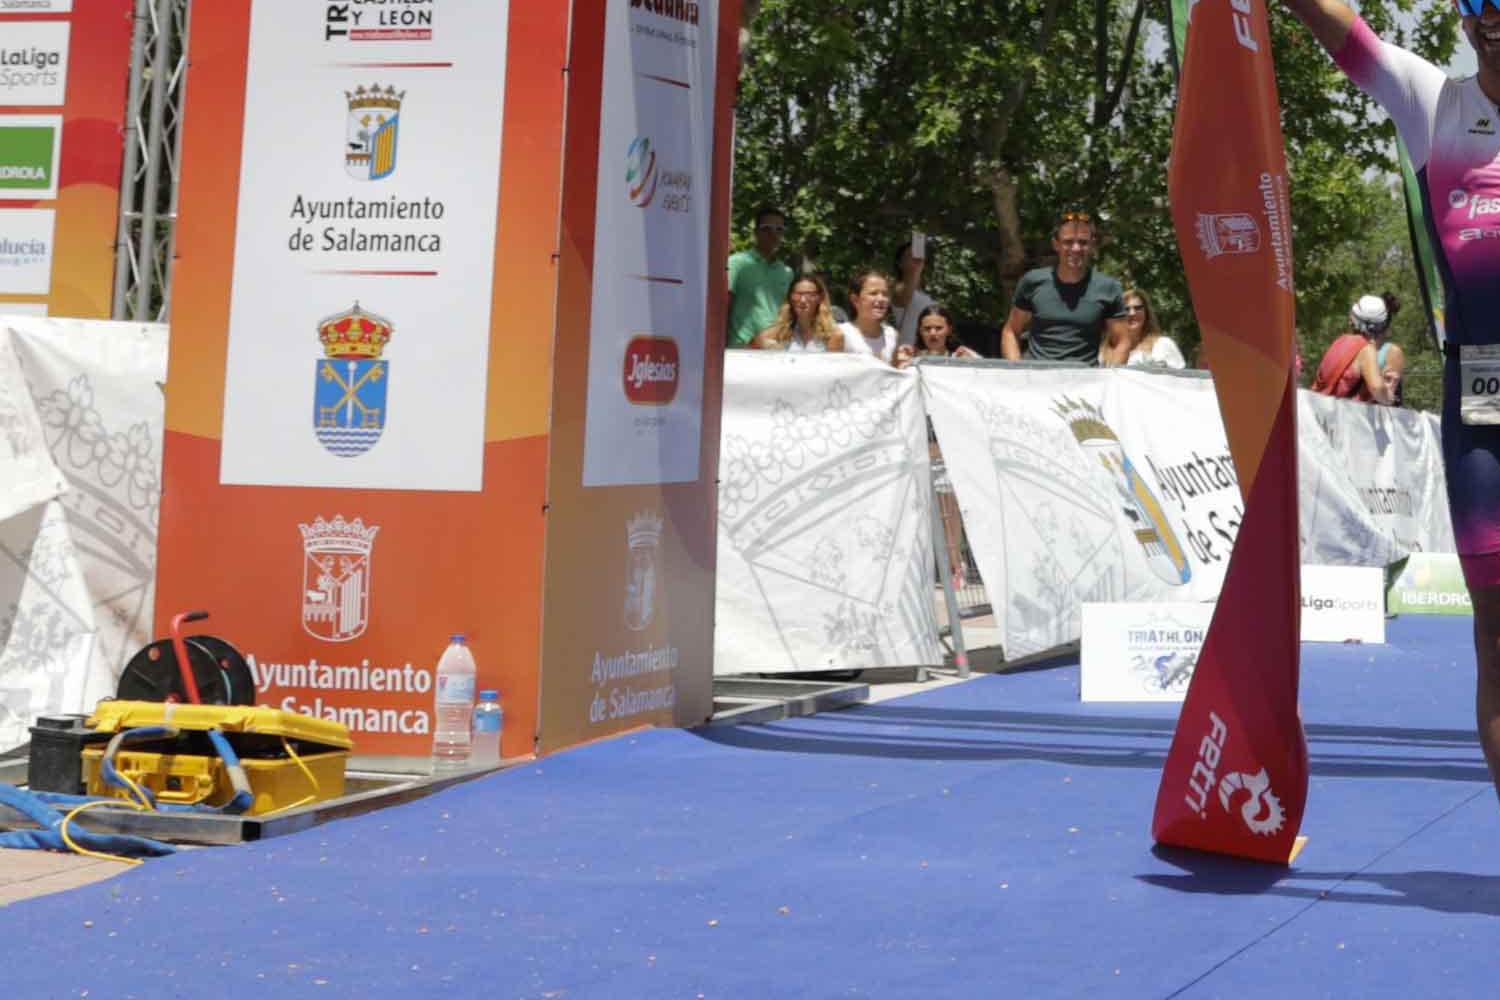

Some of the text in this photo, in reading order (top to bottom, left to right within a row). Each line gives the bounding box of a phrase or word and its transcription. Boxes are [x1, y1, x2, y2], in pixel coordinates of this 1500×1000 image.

[351, 4, 432, 25] Y LEÓN
[1, 47, 59, 70] LaLiga
[289, 194, 444, 224] Ayuntamiento
[288, 227, 441, 252] de Salamanca
[591, 643, 680, 687] Ayuntamiento
[591, 686, 675, 722] de Salamanca
